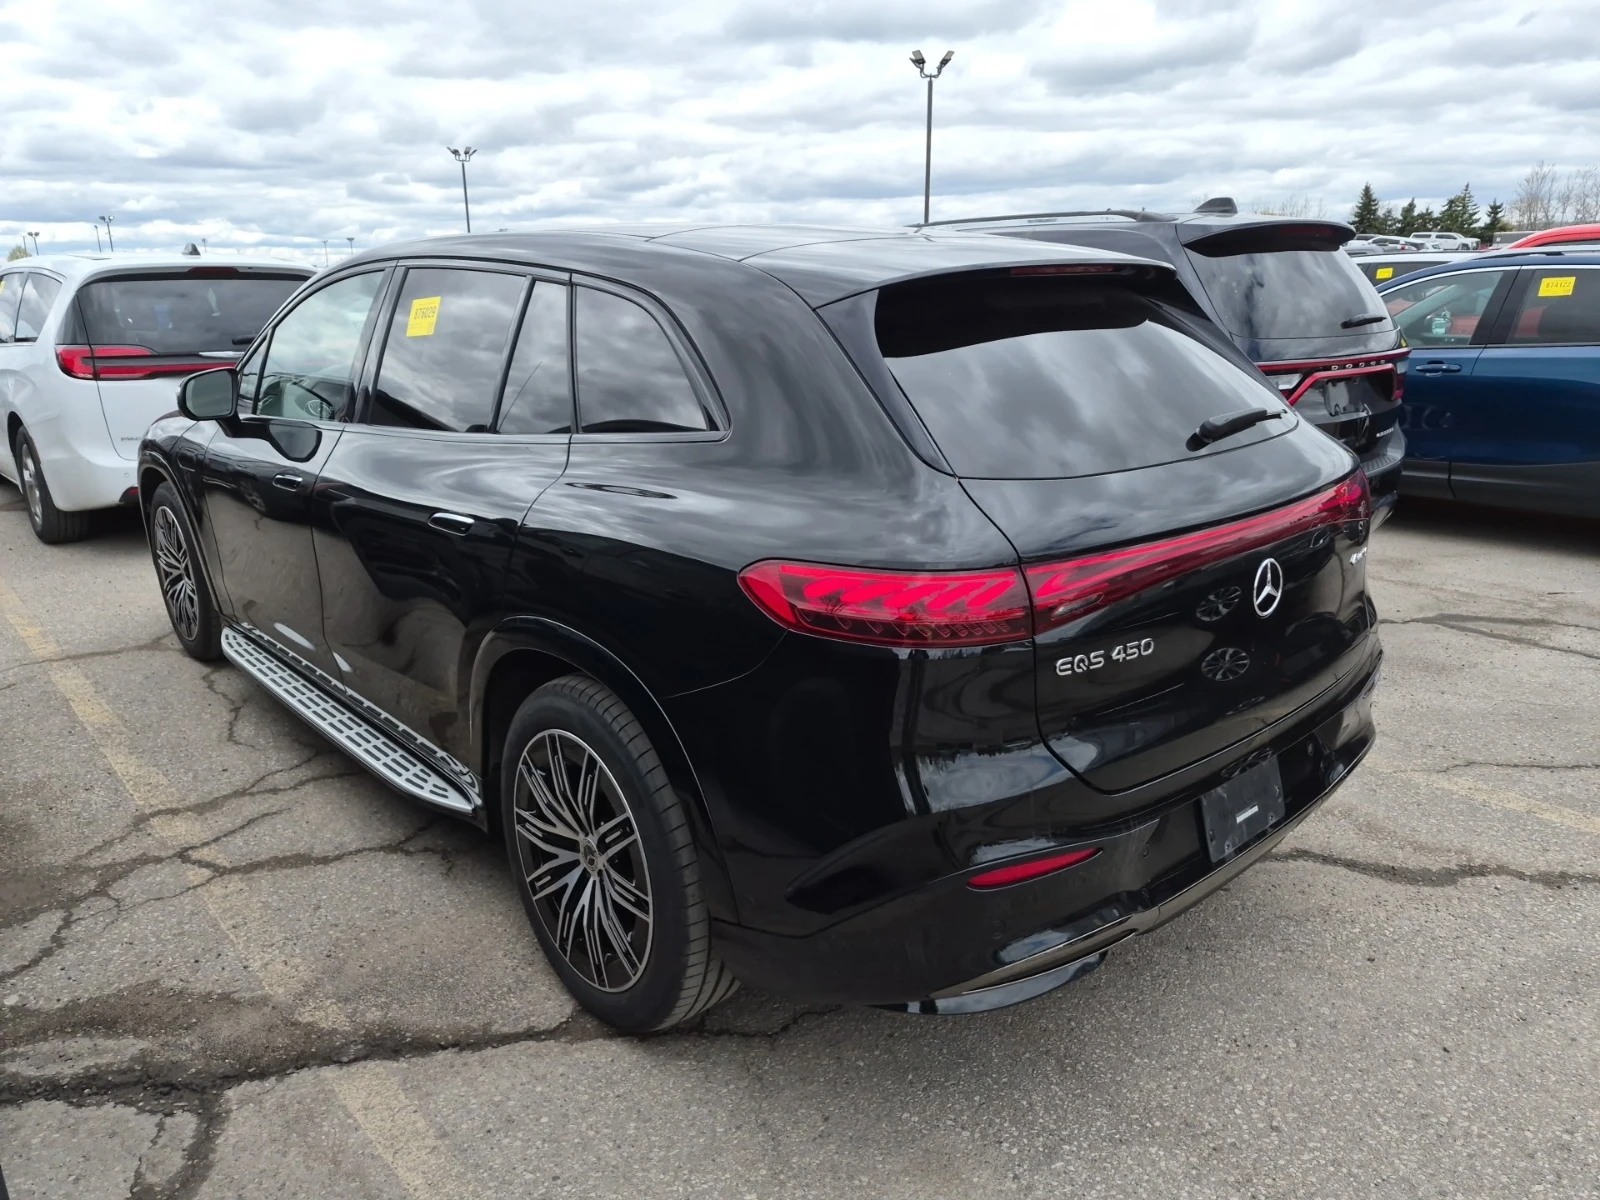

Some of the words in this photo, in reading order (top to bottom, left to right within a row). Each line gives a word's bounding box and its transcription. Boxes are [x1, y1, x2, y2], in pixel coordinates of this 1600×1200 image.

[1331, 360, 1386, 371] DODGE
[1055, 650, 1105, 676] EQS
[1110, 638, 1154, 662] 450
